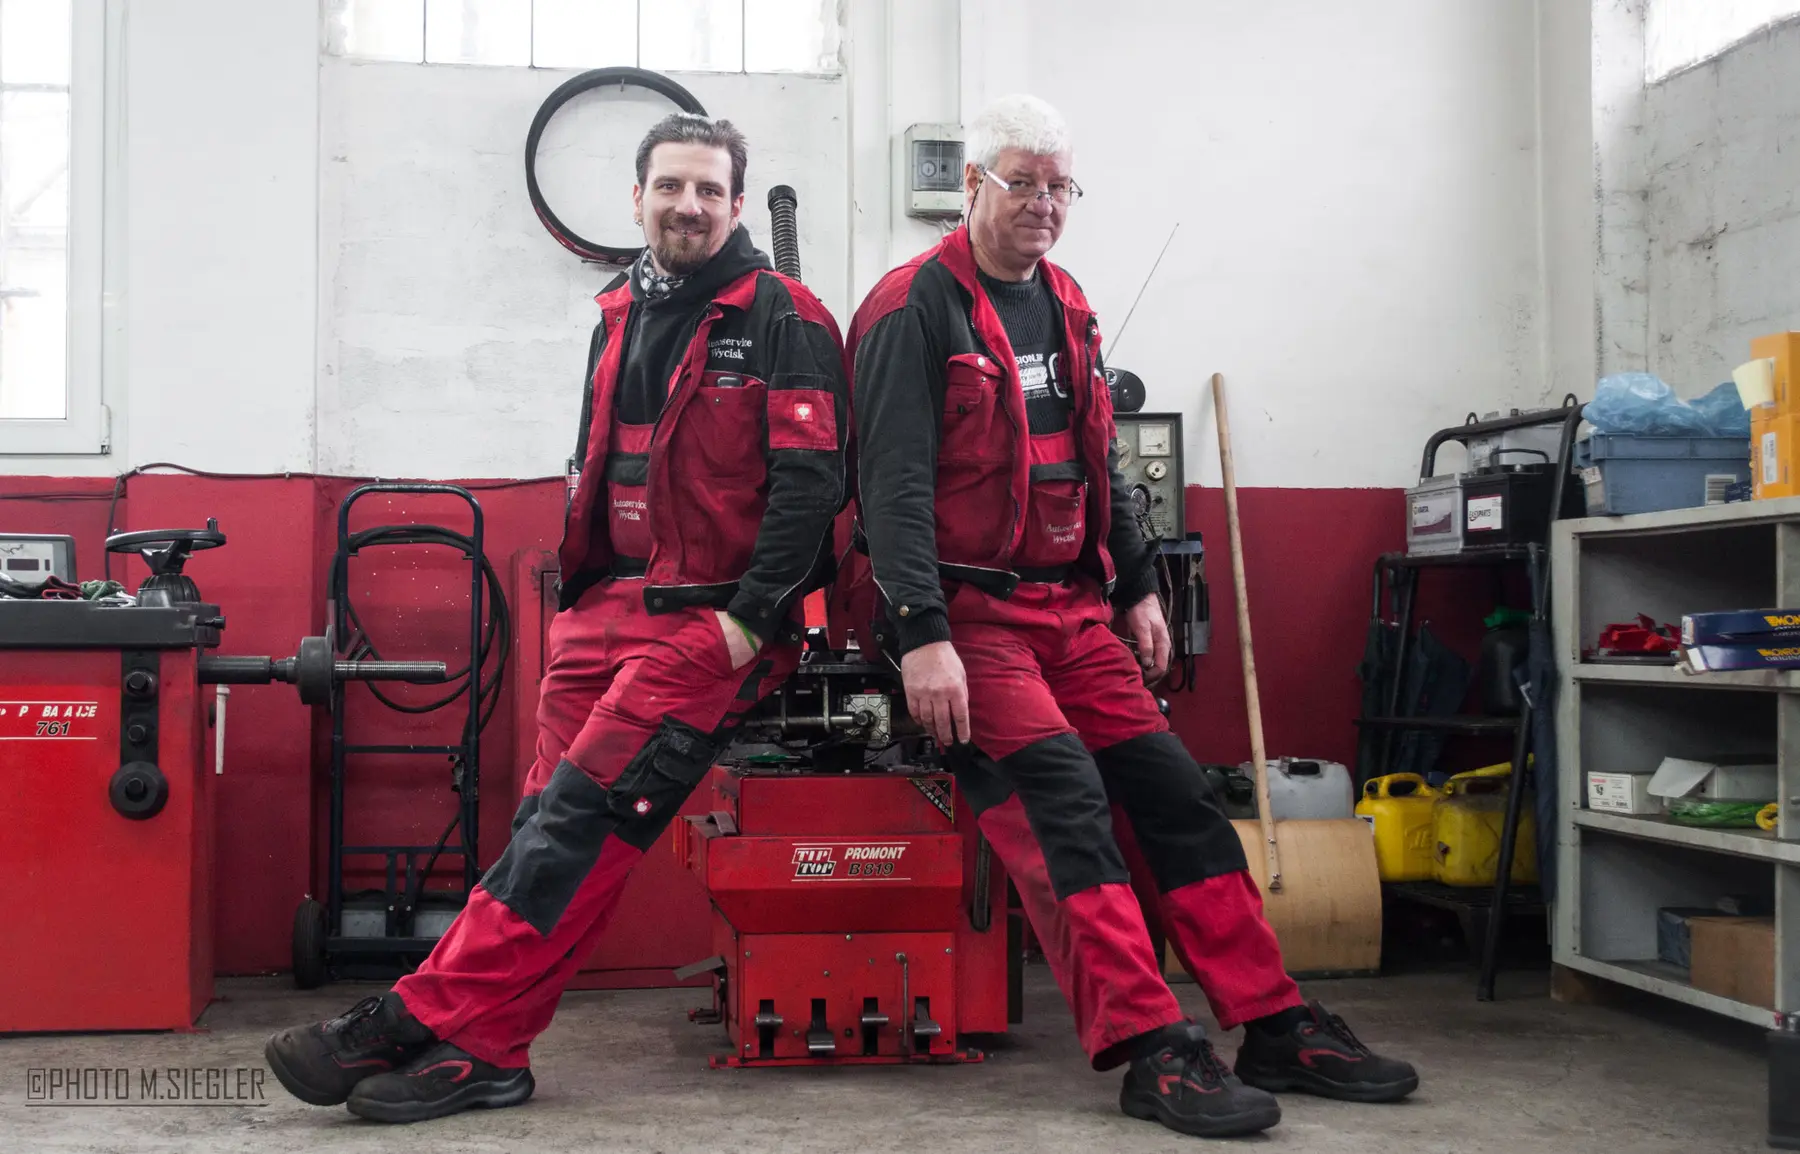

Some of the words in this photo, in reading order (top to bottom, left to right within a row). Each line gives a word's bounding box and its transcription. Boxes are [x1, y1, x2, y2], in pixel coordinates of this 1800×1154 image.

[711, 347, 744, 360] Wycisk
[36, 720, 71, 736] 761
[796, 850, 829, 862] TIP
[844, 846, 906, 860] PROMONT
[800, 861, 833, 874] TOP
[848, 863, 860, 876] B
[863, 862, 894, 876] 819
